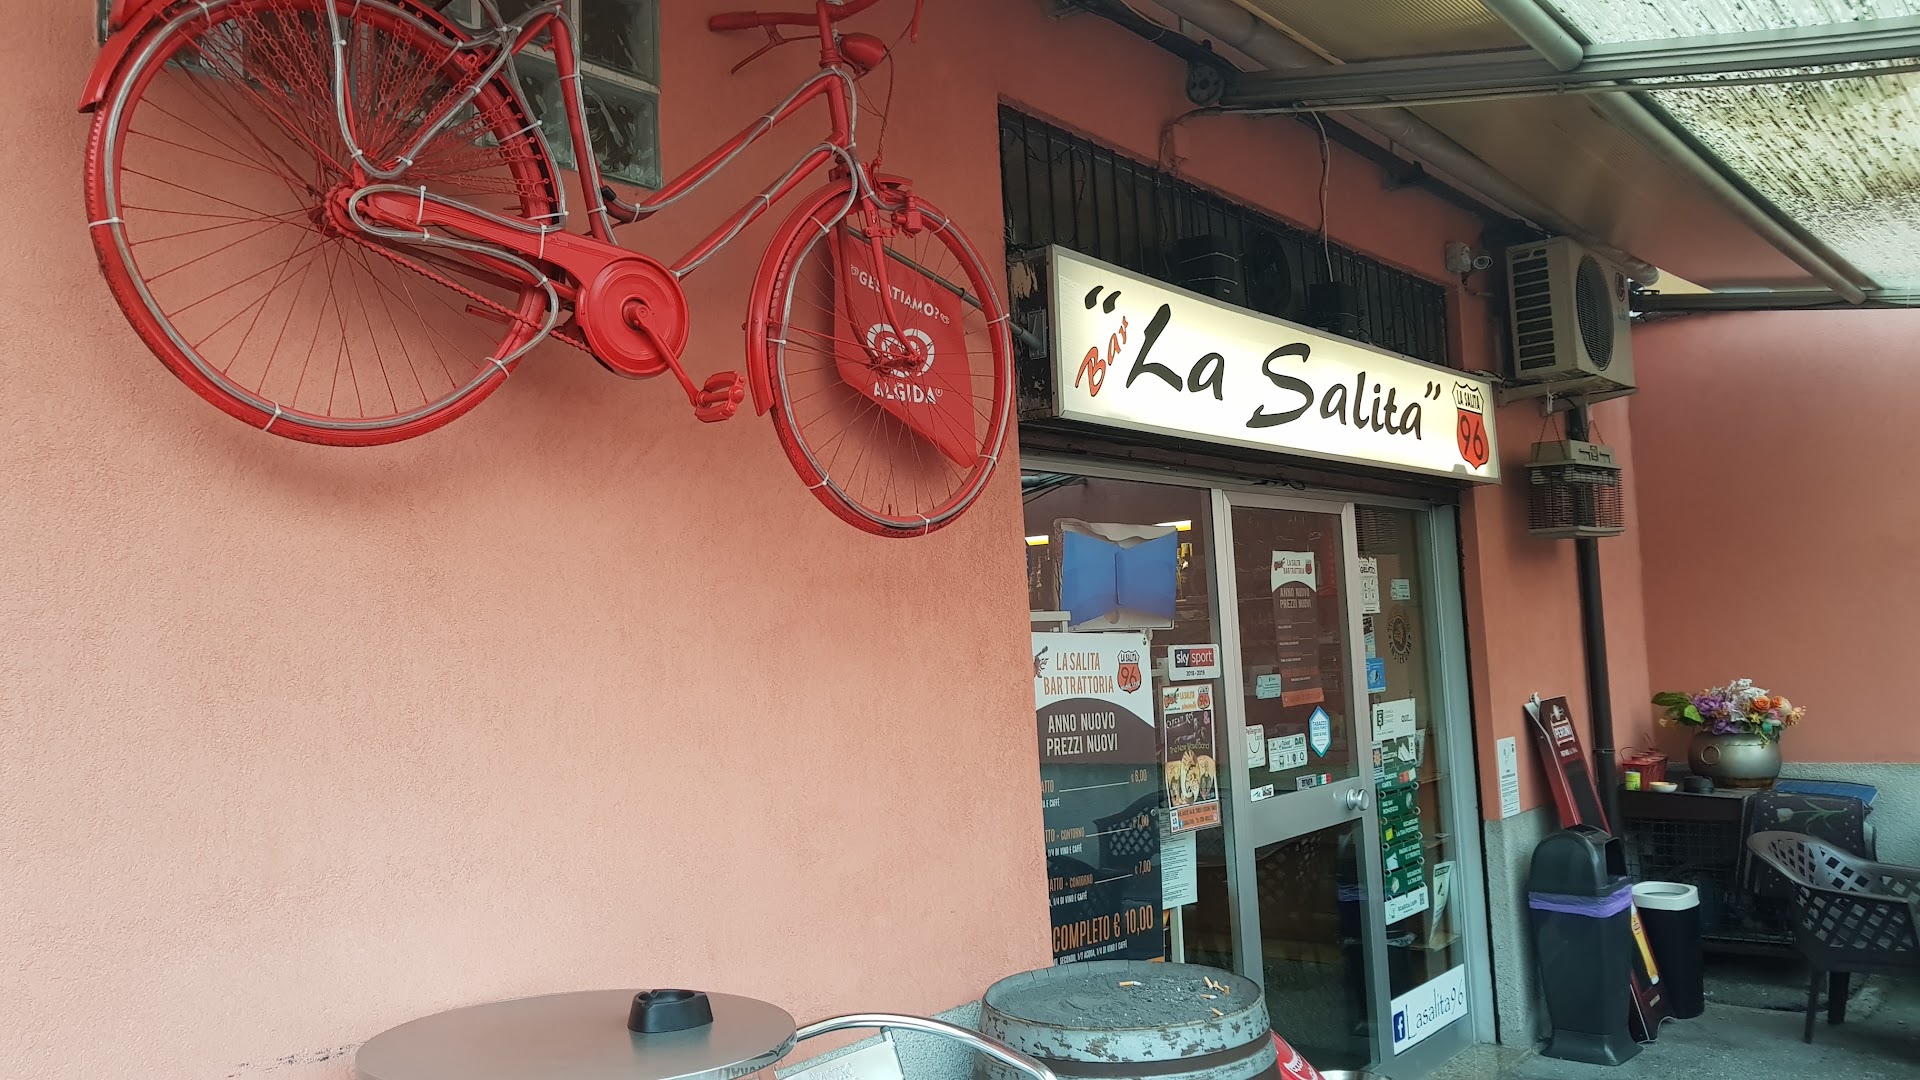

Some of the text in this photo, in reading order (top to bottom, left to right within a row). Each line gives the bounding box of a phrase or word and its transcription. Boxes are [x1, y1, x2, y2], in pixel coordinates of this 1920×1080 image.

[1075, 315, 1129, 398] Bar
[873, 380, 937, 405] ALGIDA
[1456, 389, 1481, 410] LA SALITA
[1460, 414, 1484, 461] 96
[1056, 652, 1101, 671] LA SALITA
[1176, 650, 1213, 667] sky sport
[1043, 677, 1064, 696] BAR
[1063, 675, 1114, 695] TRATTORIA
[1120, 666, 1138, 688] 96
[1048, 711, 1116, 734] ANNO NUOVO
[1046, 732, 1118, 757] PREZZI NUOVI
[1294, 737, 1304, 746] DAY
[1134, 769, 1148, 783] 6,00
[1060, 826, 1085, 841] CONTORNO
[1136, 814, 1150, 827] 7,00
[1055, 847, 1060, 857] DI
[1060, 844, 1069, 856] VINO
[1069, 873, 1094, 888] CONTORNO
[1138, 860, 1152, 875] 7,00
[1060, 896, 1065, 905] DI
[1065, 893, 1074, 904] VINO
[1052, 904, 1154, 953] COMPLETO € 10,00
